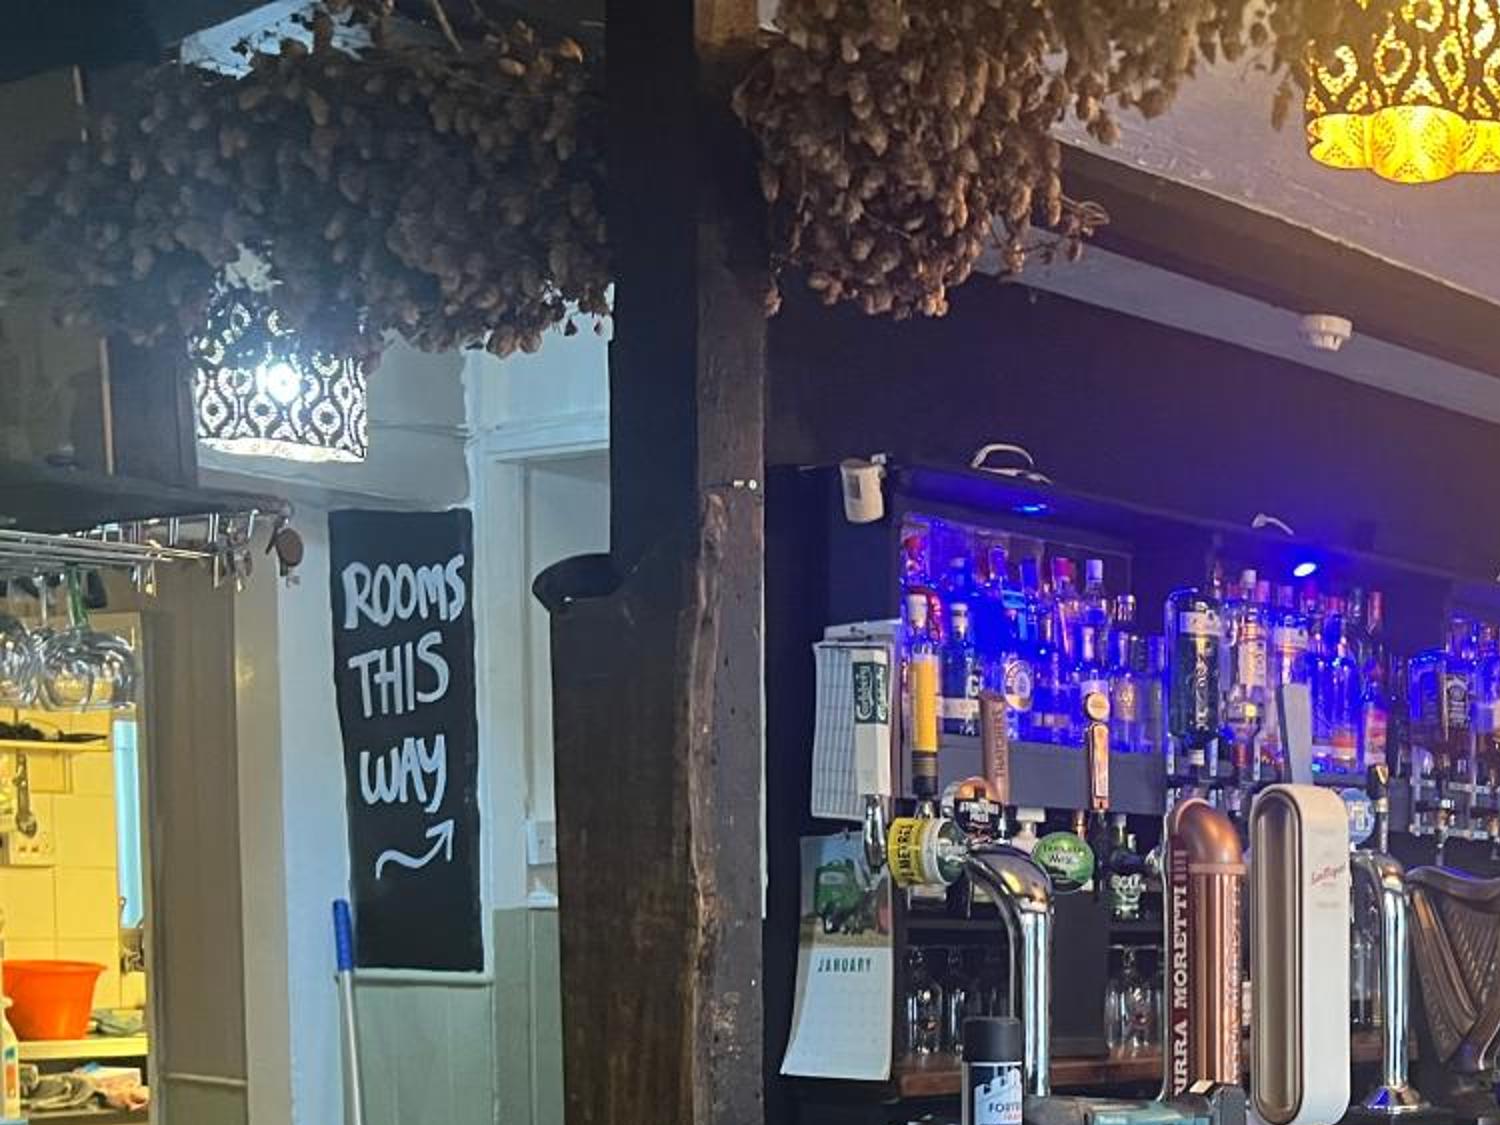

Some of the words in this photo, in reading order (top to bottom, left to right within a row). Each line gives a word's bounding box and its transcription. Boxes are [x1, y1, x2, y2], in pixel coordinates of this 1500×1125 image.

[342, 553, 465, 629] ROOMS
[348, 631, 450, 718] THIS
[359, 734, 447, 813] WAY
[817, 957, 871, 973] JANUARY
[1173, 885, 1188, 1009] MORETTI
